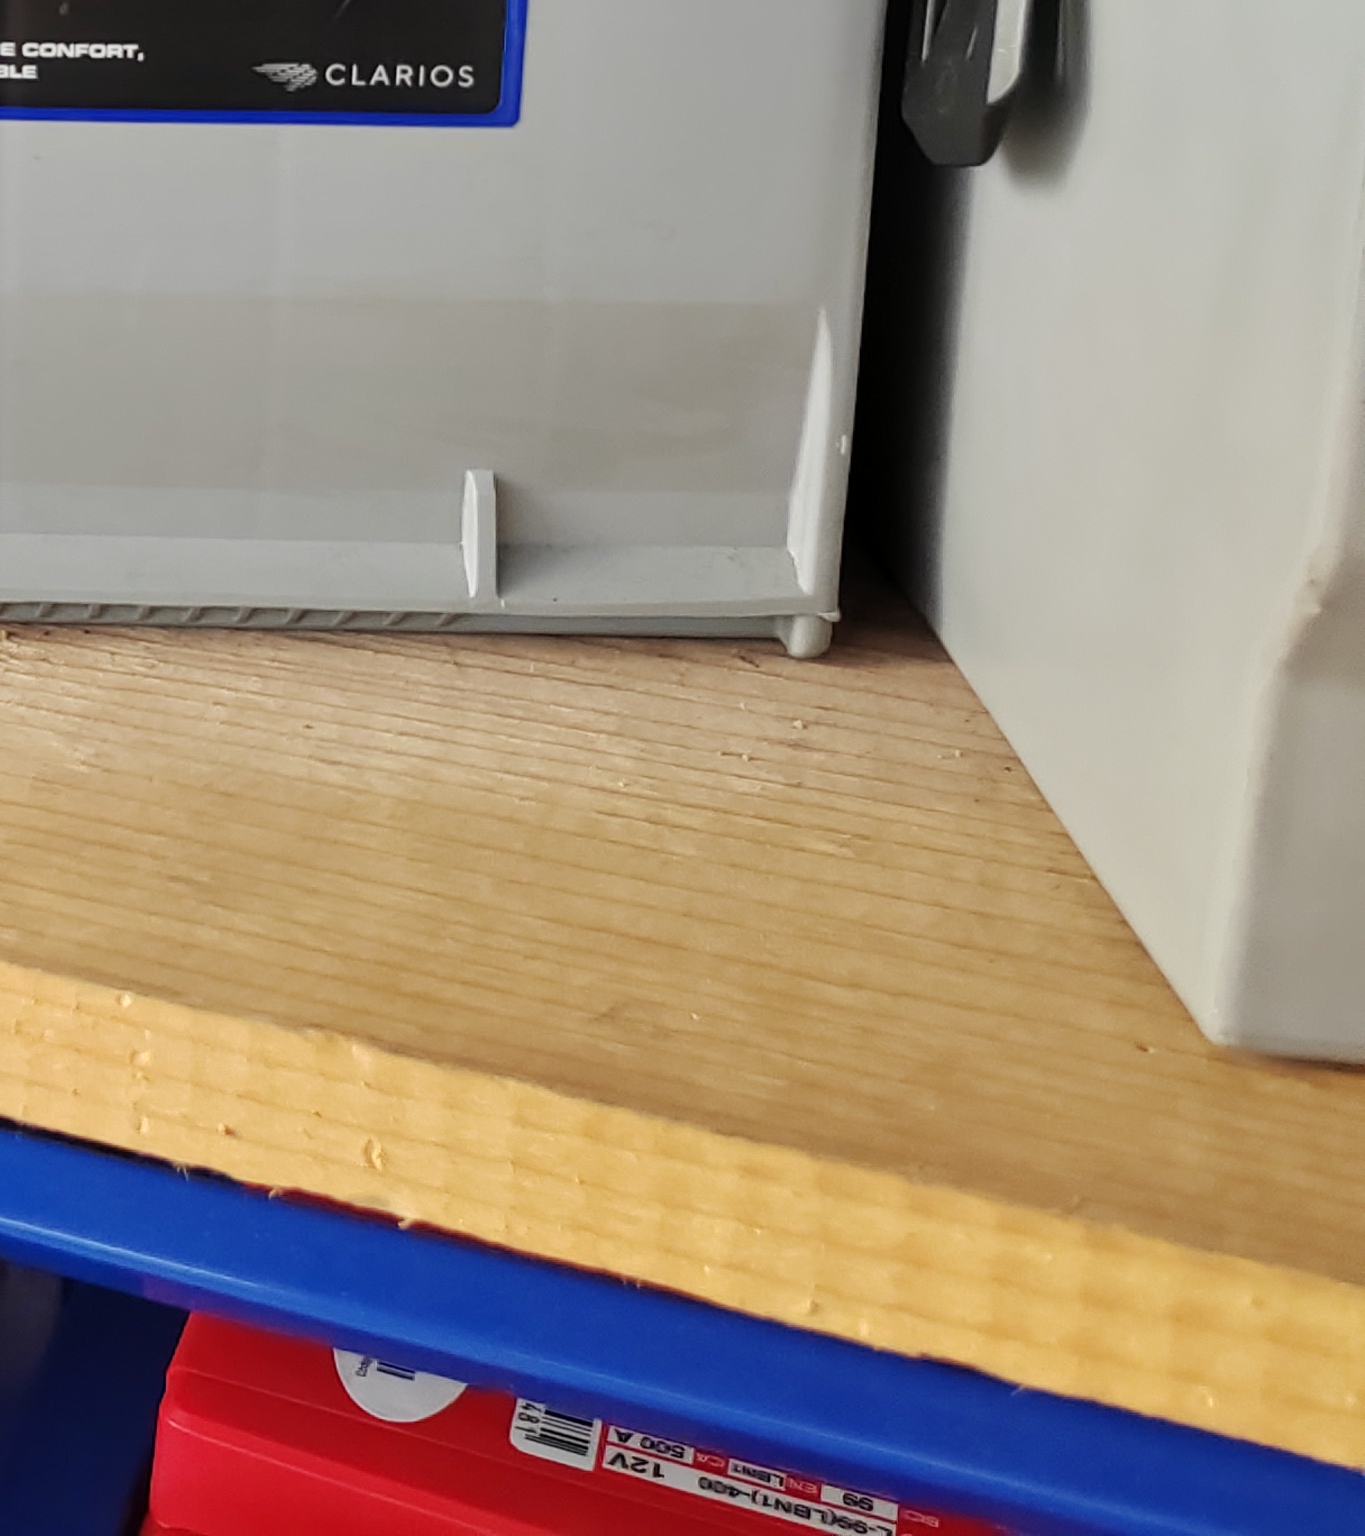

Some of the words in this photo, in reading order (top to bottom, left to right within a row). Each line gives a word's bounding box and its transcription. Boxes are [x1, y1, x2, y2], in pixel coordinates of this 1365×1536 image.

[22, 42, 144, 61] CONFORT,
[326, 64, 474, 88] CLARIOS
[609, 1452, 665, 1479] 12V
